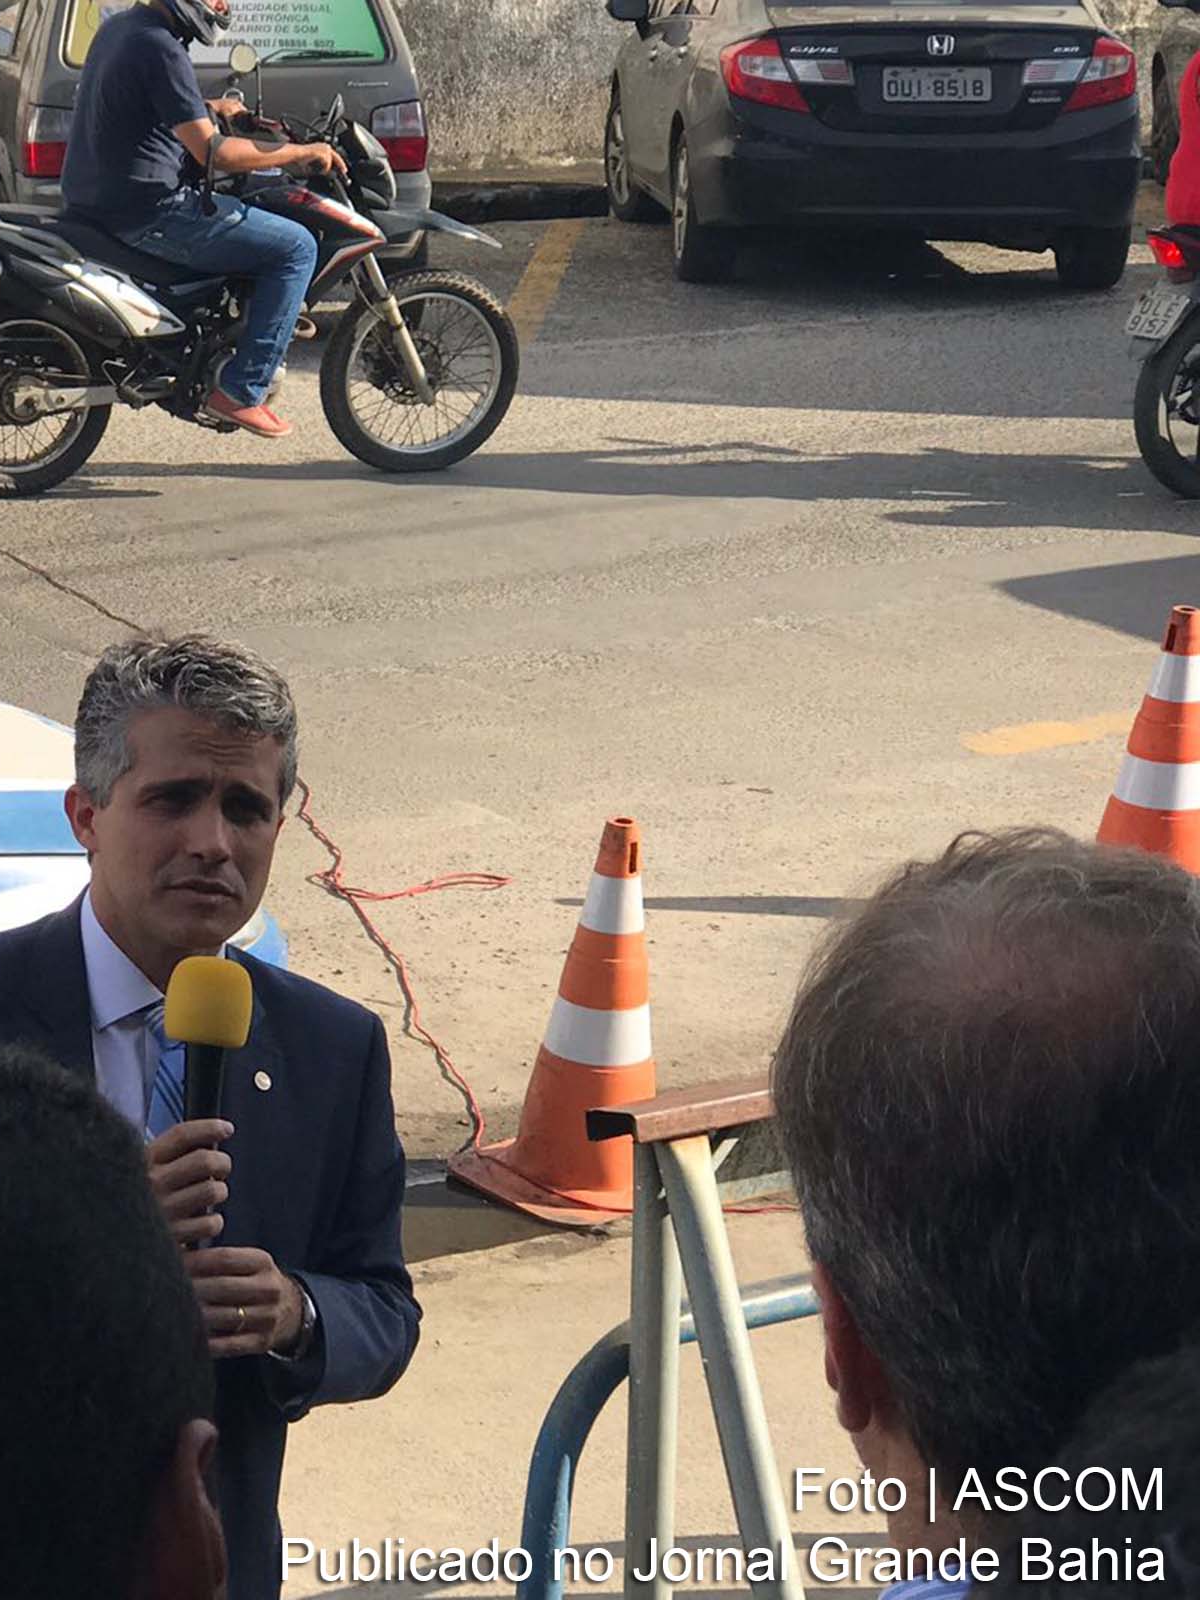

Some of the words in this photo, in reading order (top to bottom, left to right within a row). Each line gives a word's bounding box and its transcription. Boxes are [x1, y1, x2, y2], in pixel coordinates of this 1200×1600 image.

[291, 3, 332, 13] VISUAL
[274, 24, 290, 33] DE
[293, 25, 320, 33] SOM
